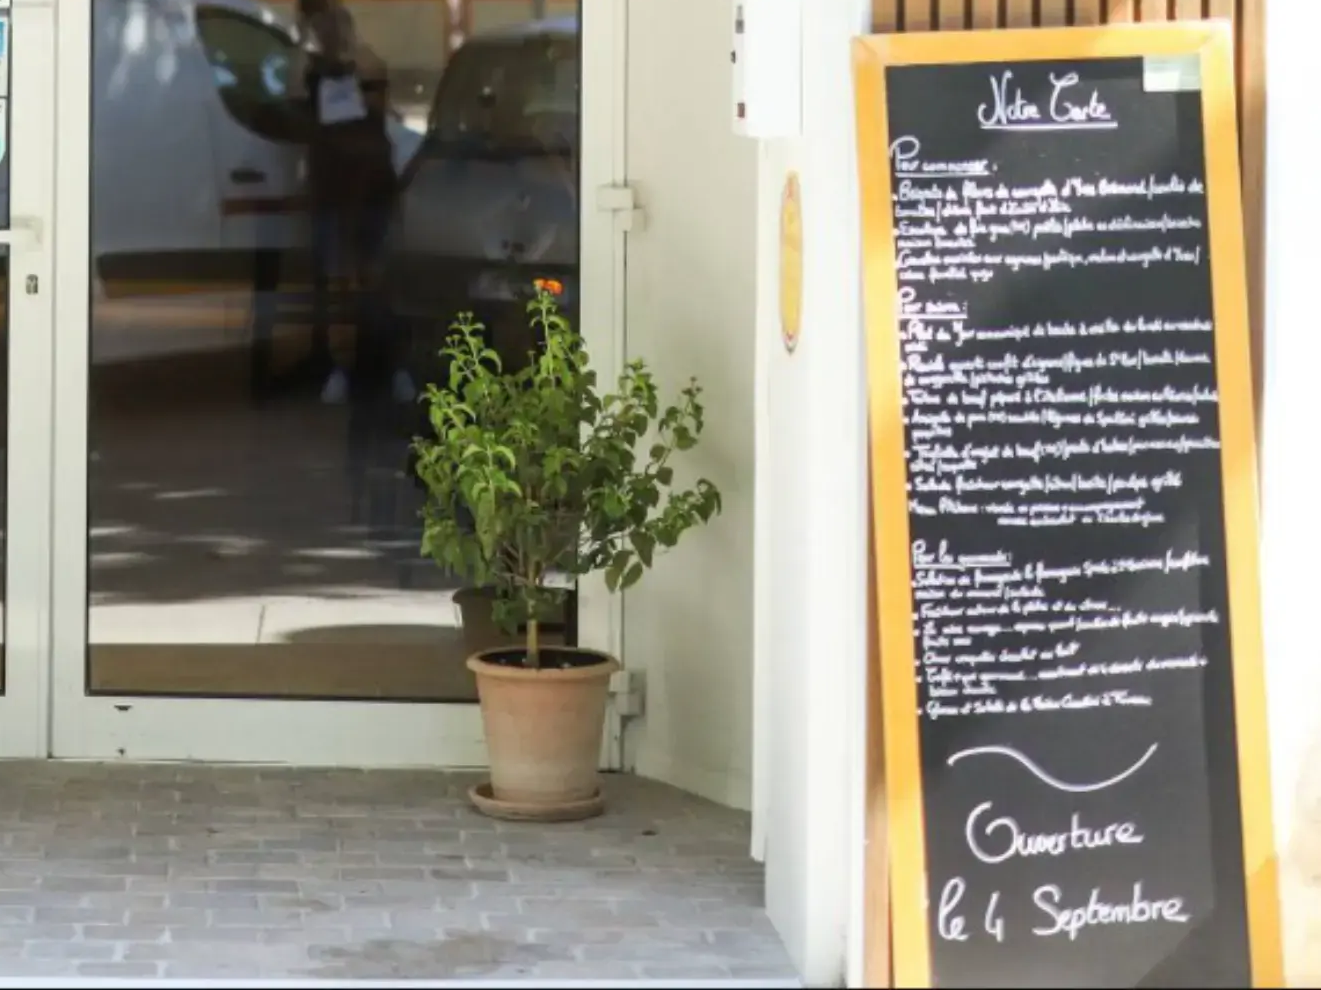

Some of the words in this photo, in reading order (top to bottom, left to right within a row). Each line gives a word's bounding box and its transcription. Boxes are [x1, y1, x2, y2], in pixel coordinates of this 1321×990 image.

[977, 70, 1041, 125] Notre
[1048, 71, 1111, 122] Carte
[965, 800, 1145, 864] Ouverture
[984, 891, 1005, 943] 4
[1032, 879, 1192, 942] Septembre
